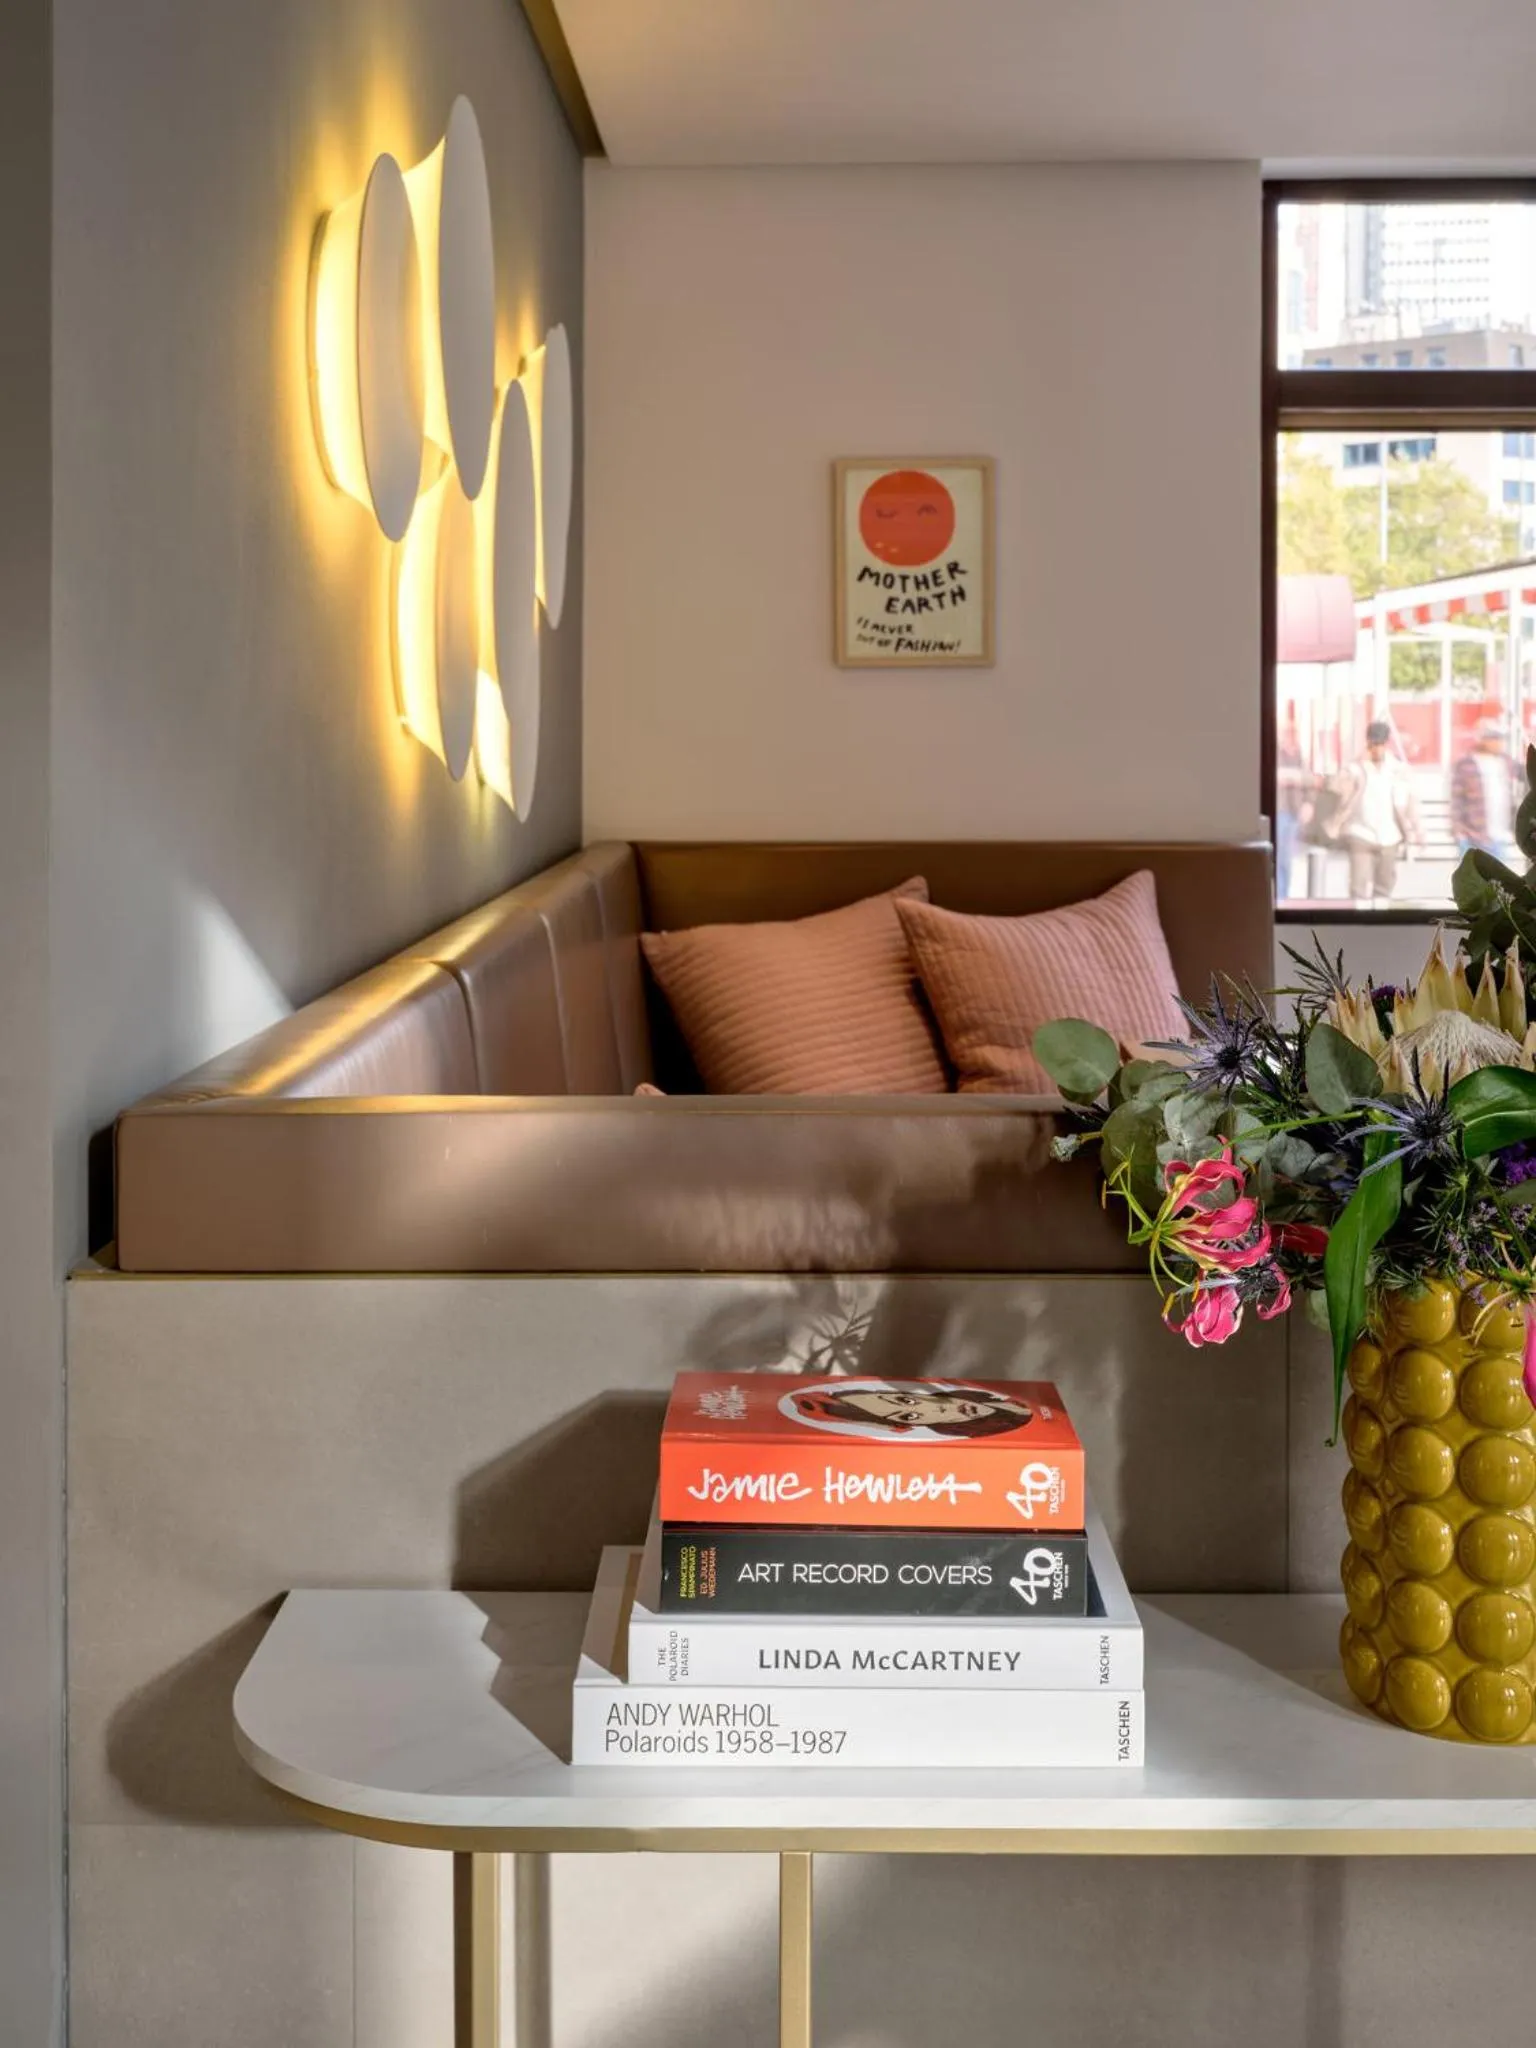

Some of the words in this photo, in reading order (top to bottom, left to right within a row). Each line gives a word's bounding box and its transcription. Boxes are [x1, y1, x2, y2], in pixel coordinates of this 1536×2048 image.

[857, 561, 968, 593] MOTHER
[885, 584, 966, 615] EARTH
[871, 622, 913, 635] NEVER
[687, 1468, 814, 1503] Jamie
[1005, 1462, 1055, 1519] 40
[1049, 1467, 1060, 1515] TASCHEN
[680, 1546, 688, 1597] FRANCESCO
[737, 1563, 785, 1583] ART
[792, 1563, 889, 1584] RECORD
[898, 1564, 992, 1585] COVERS
[1009, 1547, 1056, 1605] 40
[1052, 1551, 1063, 1600] TASCHEN
[657, 1647, 666, 1666] THE
[669, 1630, 677, 1681] POLAROID
[680, 1637, 689, 1676] DIARIES
[758, 1649, 842, 1669] LINDA
[852, 1650, 1021, 1671] McCARTNEY
[1100, 1635, 1109, 1684] TASCHEN
[606, 1703, 672, 1727] ANDY
[678, 1703, 780, 1728] WARHOL
[1118, 1700, 1130, 1761] TASCHEN
[605, 1729, 709, 1754] Polaroids
[715, 1730, 847, 1754] 1958–1987
